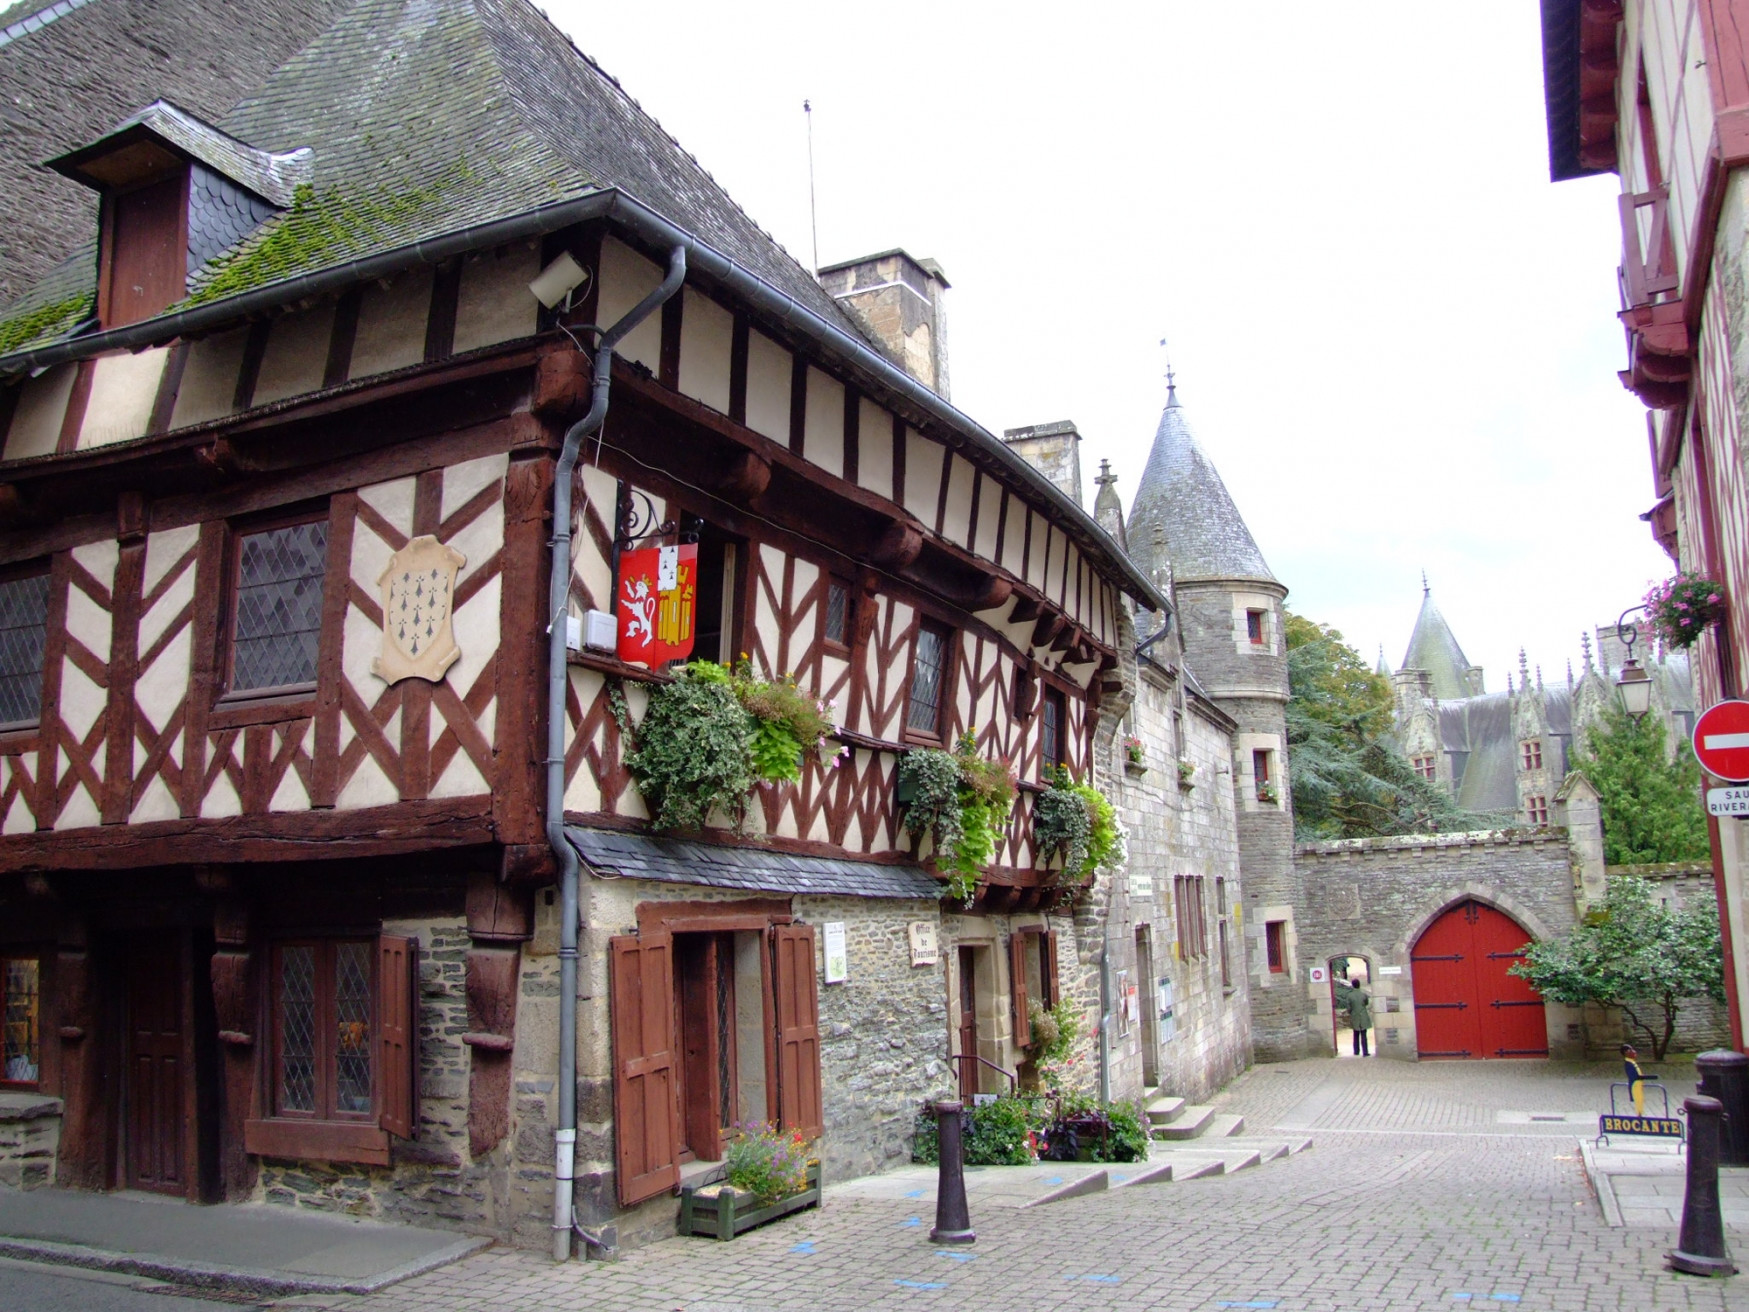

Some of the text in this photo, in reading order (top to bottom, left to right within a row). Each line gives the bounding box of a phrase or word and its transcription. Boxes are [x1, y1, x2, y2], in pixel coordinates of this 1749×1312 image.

[1711, 802, 1749, 812] RIVER
[916, 923, 931, 935] Office
[921, 938, 928, 946] de
[1605, 1118, 1680, 1134] BROCANTE
